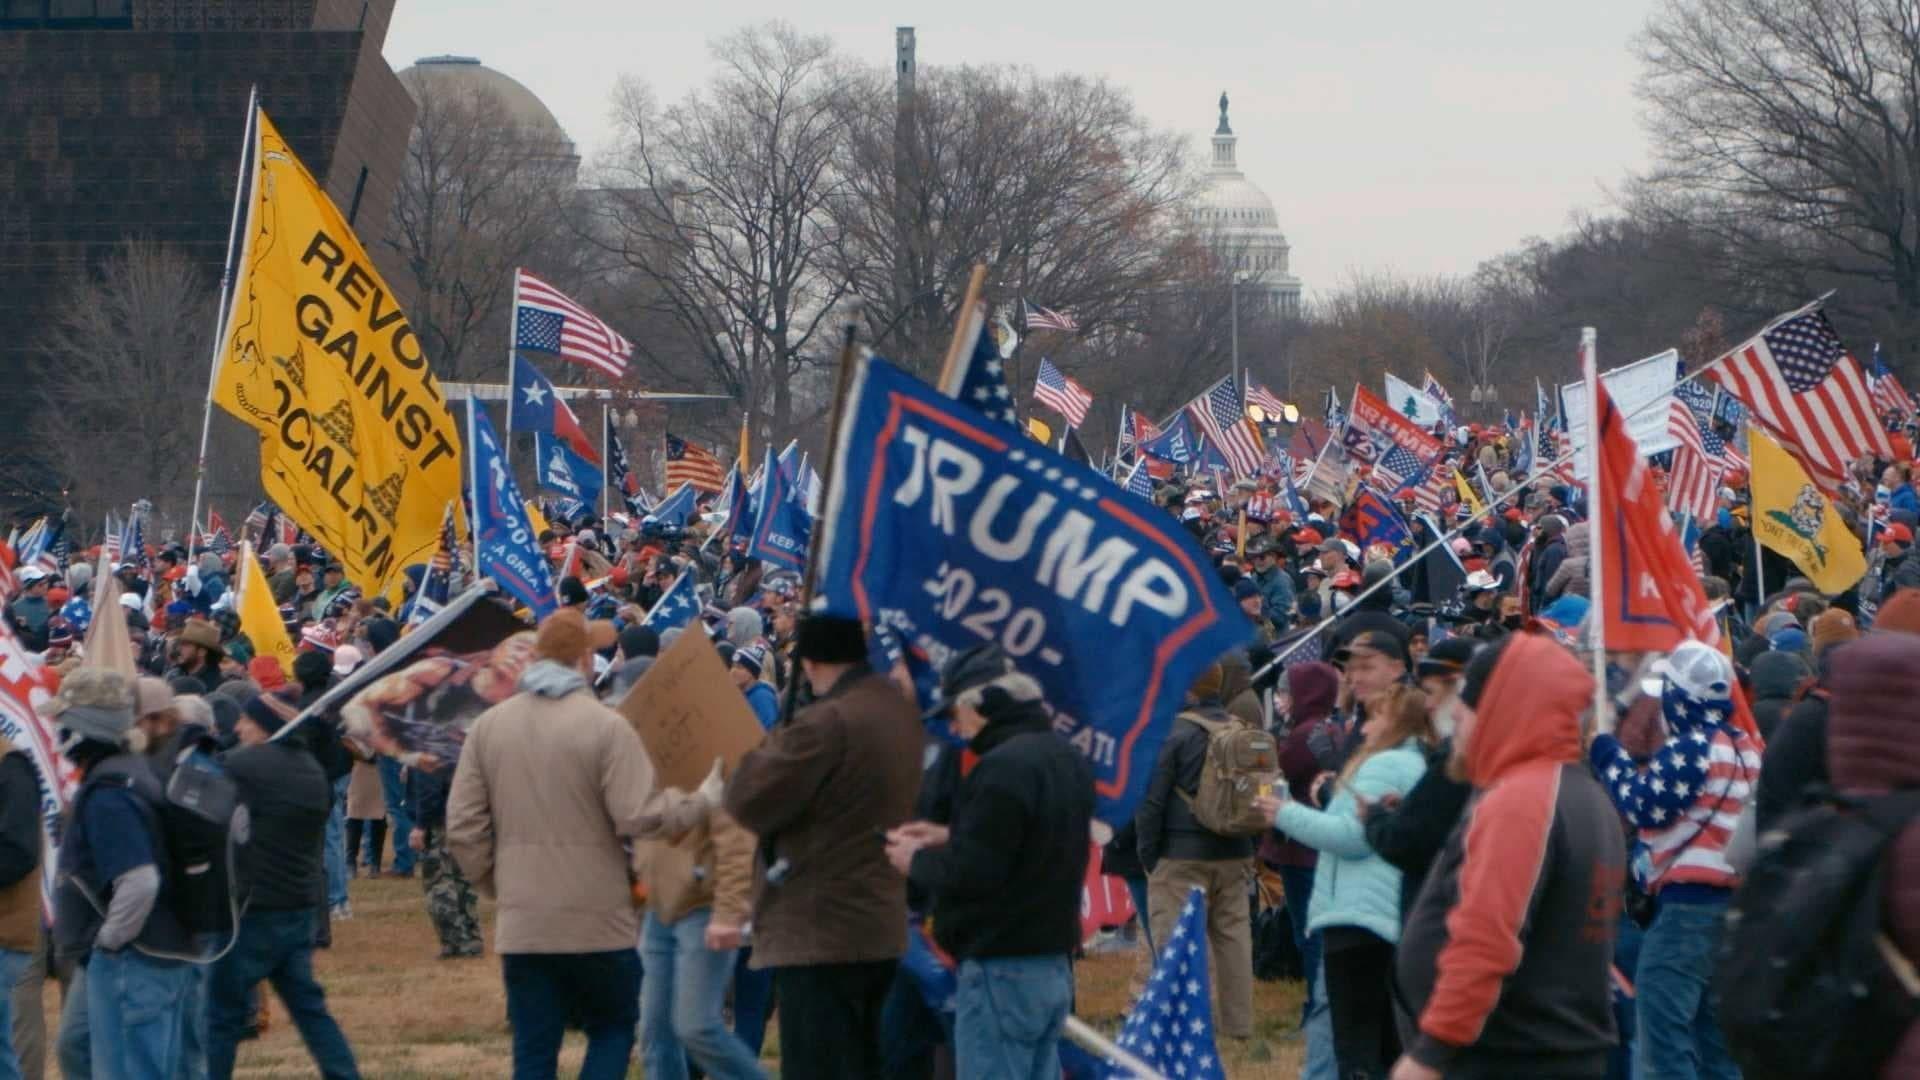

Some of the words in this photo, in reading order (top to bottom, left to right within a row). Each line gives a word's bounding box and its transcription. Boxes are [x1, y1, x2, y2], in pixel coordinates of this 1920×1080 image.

[300, 229, 452, 416] REVOL
[505, 553, 541, 593] GREA
[893, 424, 1188, 627] TRUMP
